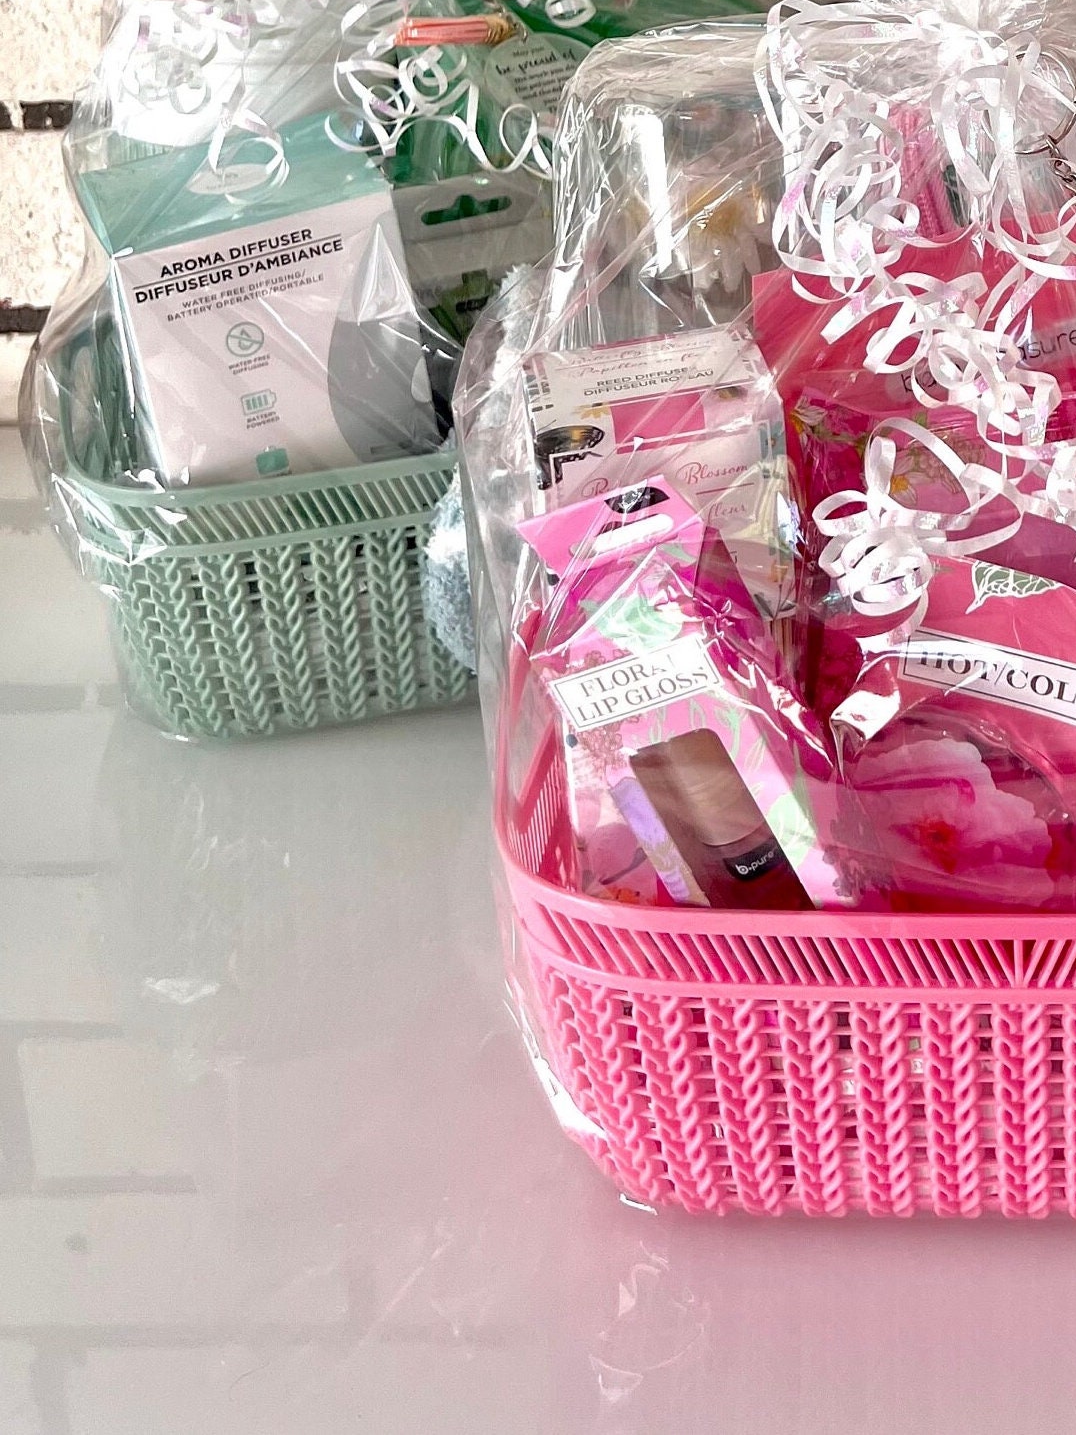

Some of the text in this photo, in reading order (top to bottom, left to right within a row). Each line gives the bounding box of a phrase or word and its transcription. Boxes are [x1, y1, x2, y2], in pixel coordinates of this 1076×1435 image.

[160, 228, 314, 278] AROMA DIFFUSER
[135, 238, 344, 304] DIFFUSEUR D'AMBIANCE
[182, 294, 218, 309] WATER
[220, 286, 245, 301] FREE
[167, 303, 213, 322] BATTERY
[583, 369, 715, 397] DIFFUSEUR ROAU
[597, 375, 633, 387] REED
[675, 461, 748, 485] Blossom
[577, 666, 709, 722] LIP GLOSS
